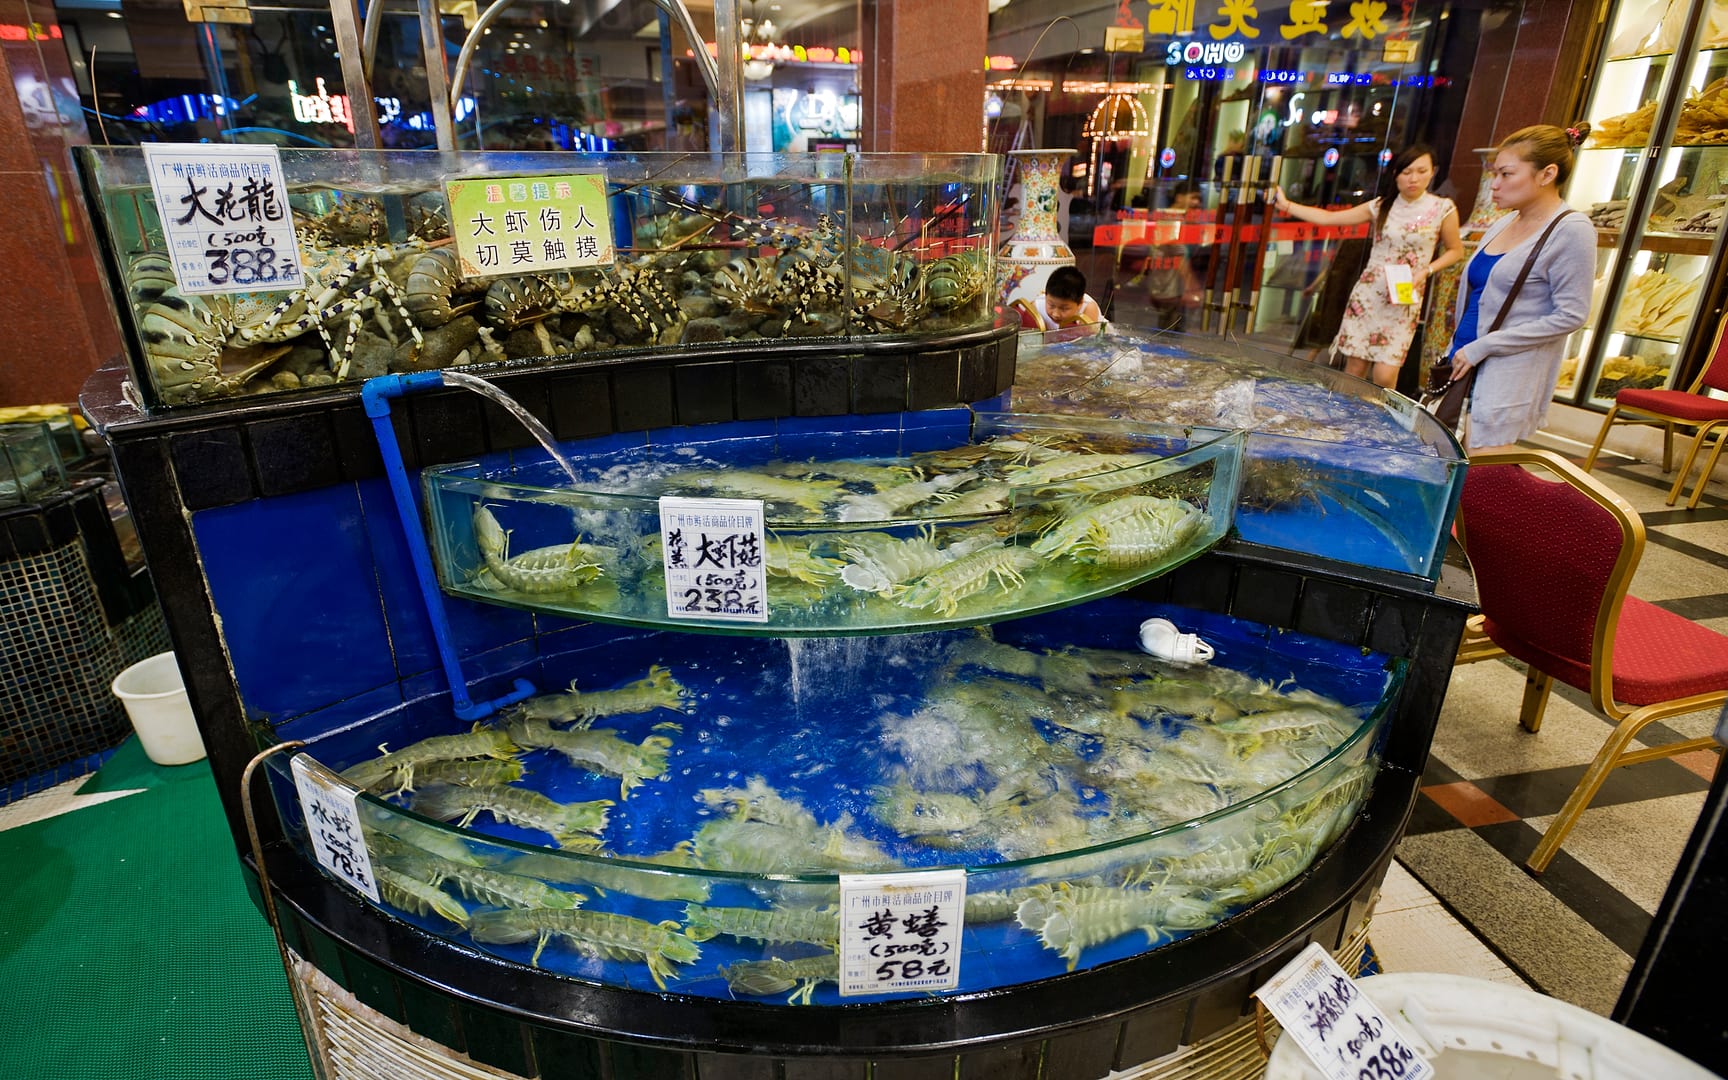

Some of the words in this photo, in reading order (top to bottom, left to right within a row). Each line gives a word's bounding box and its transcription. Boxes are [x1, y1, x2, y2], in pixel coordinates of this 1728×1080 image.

[1166, 41, 1245, 65] SOHO
[161, 163, 271, 179] 广州市鲜活商品价目牌
[487, 182, 572, 203] 温馨提示
[471, 206, 595, 236] 大虾伤人
[476, 236, 599, 267] 切莫触摸
[205, 247, 299, 285] 388元
[669, 514, 753, 528] 广州市鲜活商品价目牌
[325, 844, 370, 888] 78元
[852, 891, 953, 908] 广州市鲜活商品价目牌
[869, 938, 950, 958] (500克)
[876, 959, 951, 981] 58元
